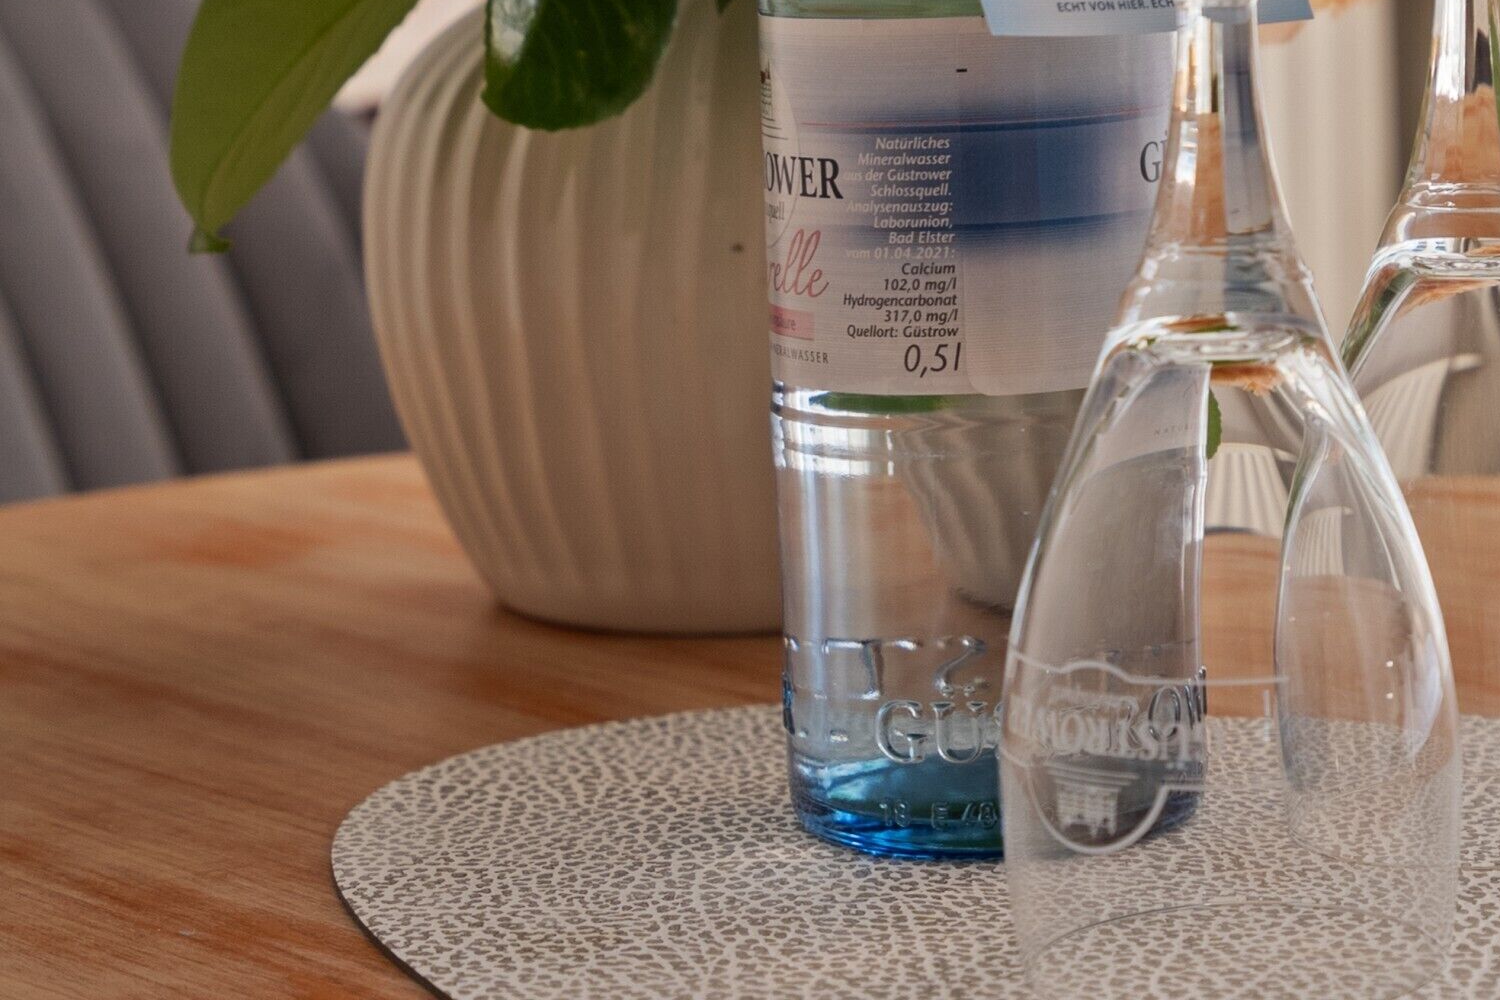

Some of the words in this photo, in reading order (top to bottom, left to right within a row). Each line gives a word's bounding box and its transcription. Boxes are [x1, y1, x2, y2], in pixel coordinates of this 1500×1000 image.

[1057, 1, 1087, 13] ECHT
[1090, 0, 1115, 12] VON
[1118, 0, 1149, 11] HIER.
[875, 136, 950, 150] Natürliches
[857, 152, 952, 166] Mineralwasser
[865, 169, 883, 181] der
[887, 168, 952, 182] Güstrower
[870, 183, 952, 201] Schlossquell.
[847, 201, 954, 216] Analysenauszug:
[873, 216, 953, 230] Laborunion,
[889, 231, 914, 245] Bad
[918, 231, 956, 245] Elster
[874, 247, 956, 260] 01.04.2021:
[901, 262, 956, 275] Calcium
[884, 278, 920, 293] 102,0
[924, 278, 957, 294] mg/l
[843, 294, 957, 310] Hydrogencarbonat
[884, 309, 921, 324] 317,0
[925, 308, 958, 325] mg/l
[847, 325, 898, 339] Quellort:
[903, 325, 959, 338] Güstrow
